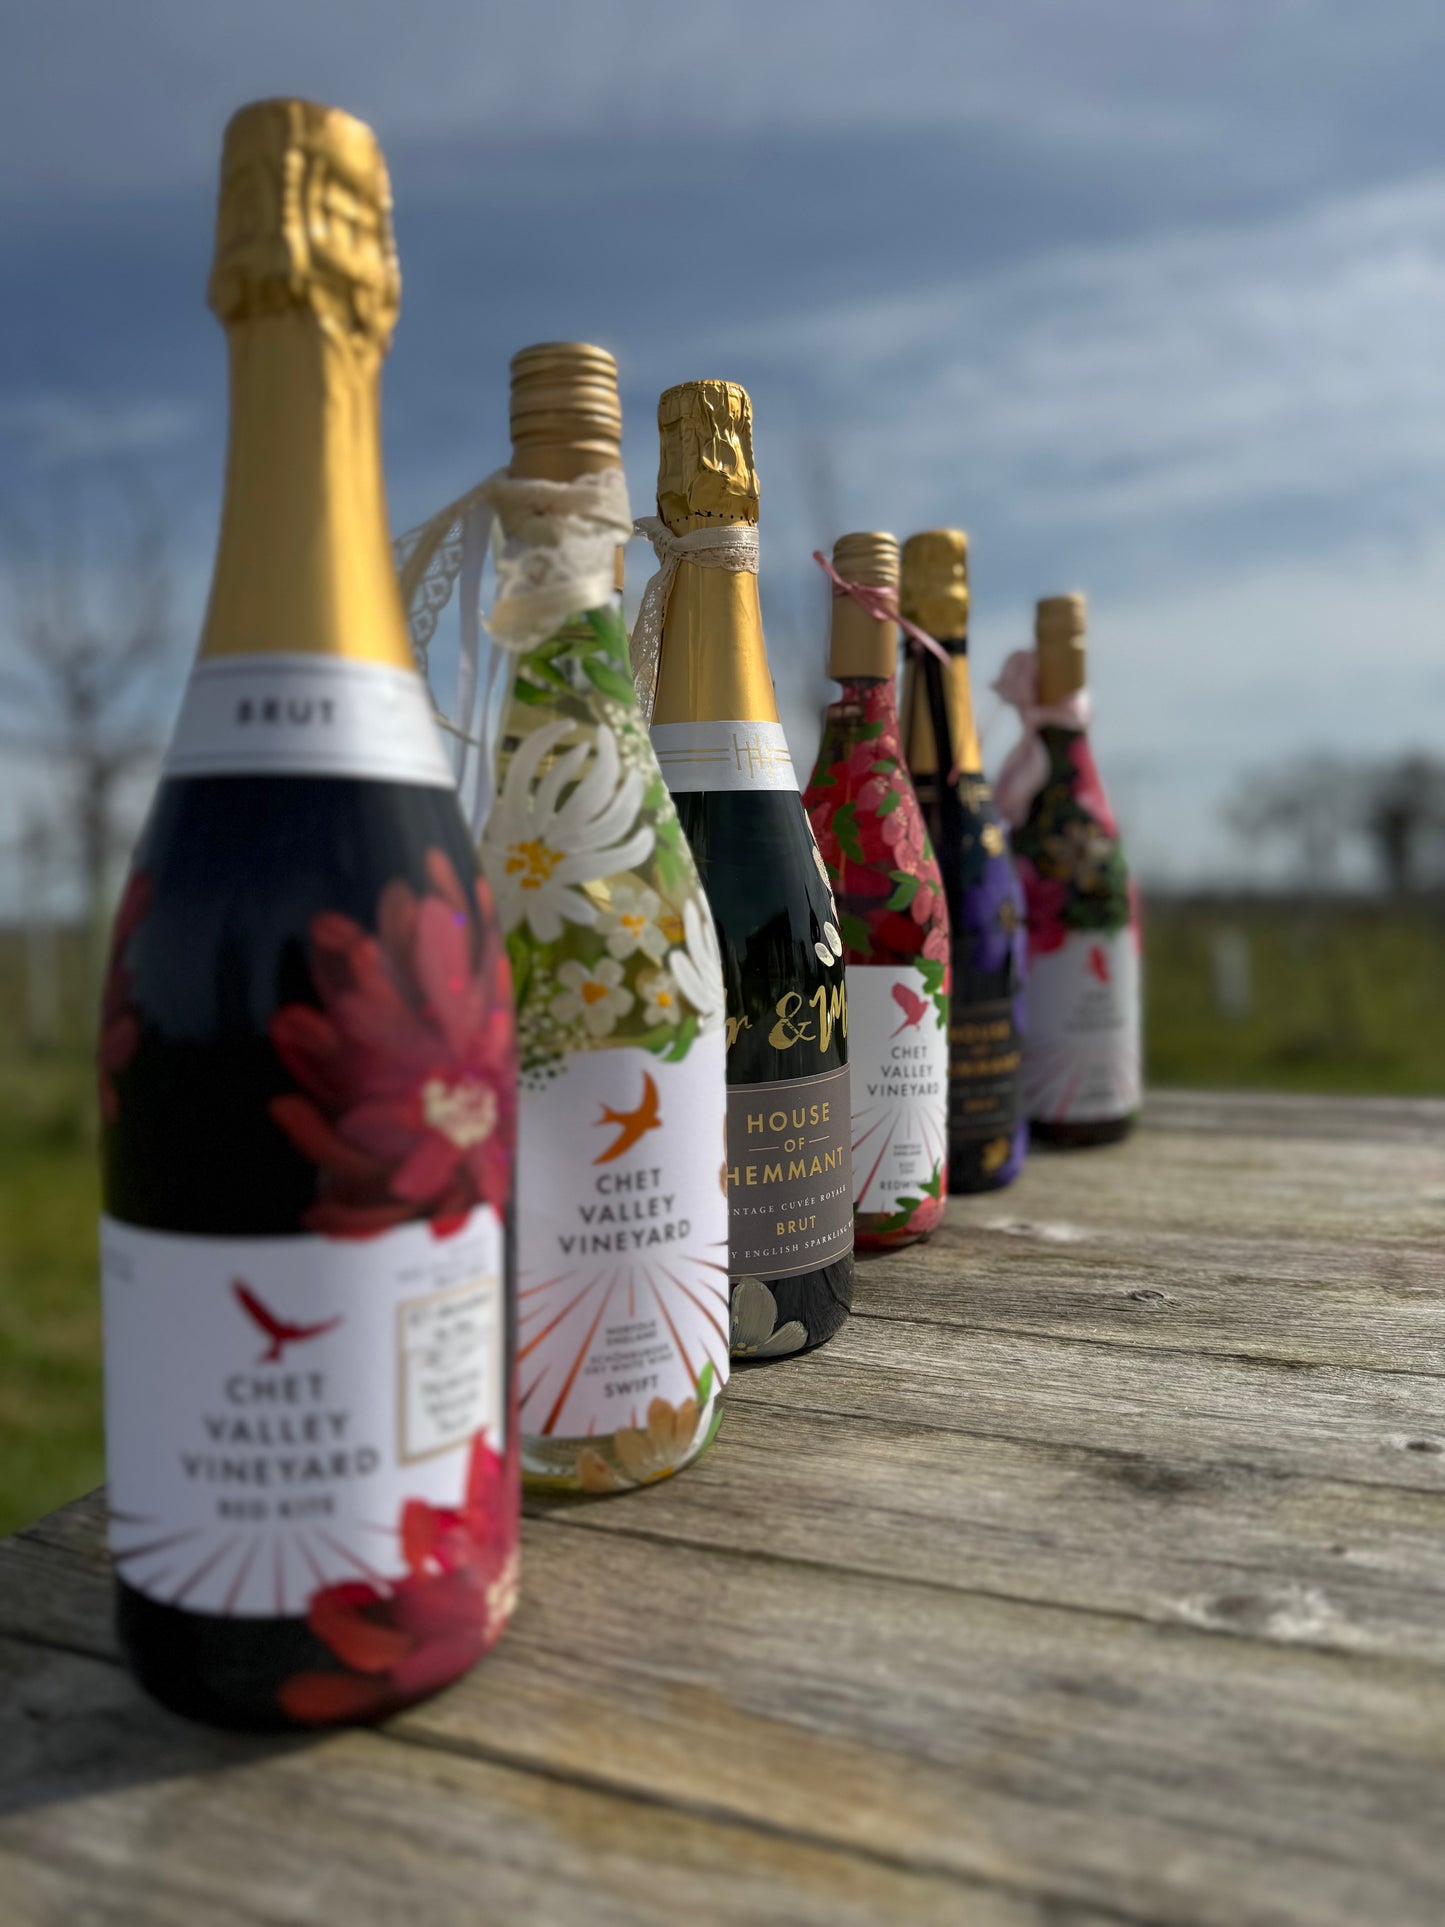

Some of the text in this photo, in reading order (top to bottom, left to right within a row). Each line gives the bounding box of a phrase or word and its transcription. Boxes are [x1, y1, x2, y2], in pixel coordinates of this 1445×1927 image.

[236, 697, 335, 725] BRUT
[768, 991, 817, 1050] &
[890, 1046, 927, 1059] CHET
[880, 1063, 934, 1079] VALLEY
[867, 1082, 939, 1097] VINEYARD
[747, 1102, 830, 1134] HOUSE
[784, 1137, 805, 1153] OF
[595, 1167, 661, 1195] CHET
[727, 1146, 843, 1186] HEMMANT
[578, 1193, 676, 1226] VALLEY
[781, 1197, 816, 1211] CUVÉE
[820, 1184, 846, 1202] ROYALE
[557, 1218, 692, 1254] VINEYARD
[776, 1215, 816, 1235] BRUT
[745, 1243, 799, 1258] ENGLISH
[804, 1225, 847, 1249] SPARKLING
[225, 1371, 325, 1406] CHET
[604, 1374, 658, 1398] SWIFT
[202, 1411, 350, 1446] VALLEY
[180, 1447, 381, 1487] VINEYARD
